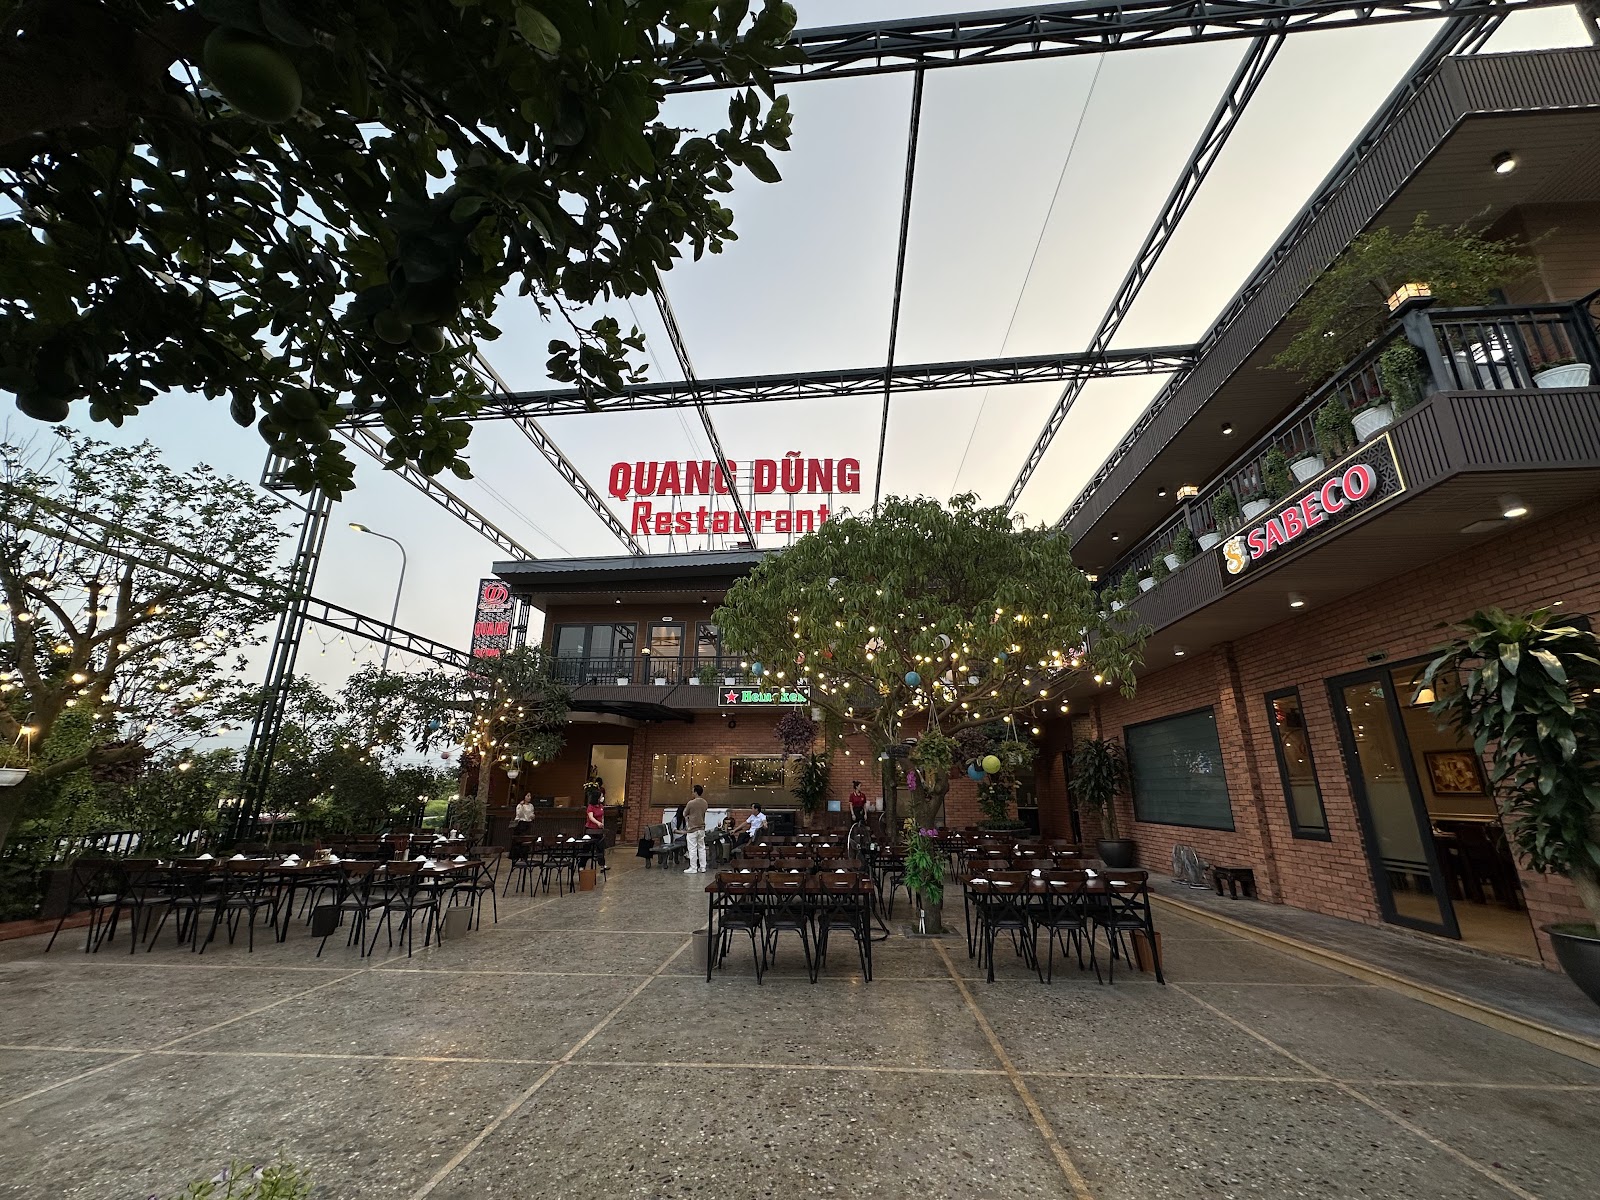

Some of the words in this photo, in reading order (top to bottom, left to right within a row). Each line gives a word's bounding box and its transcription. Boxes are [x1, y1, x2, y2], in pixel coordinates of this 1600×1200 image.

[608, 459, 737, 501] QUANG
[753, 451, 860, 494] DŨNG
[1248, 463, 1374, 560] SABECO
[741, 690, 807, 703] Heinken
